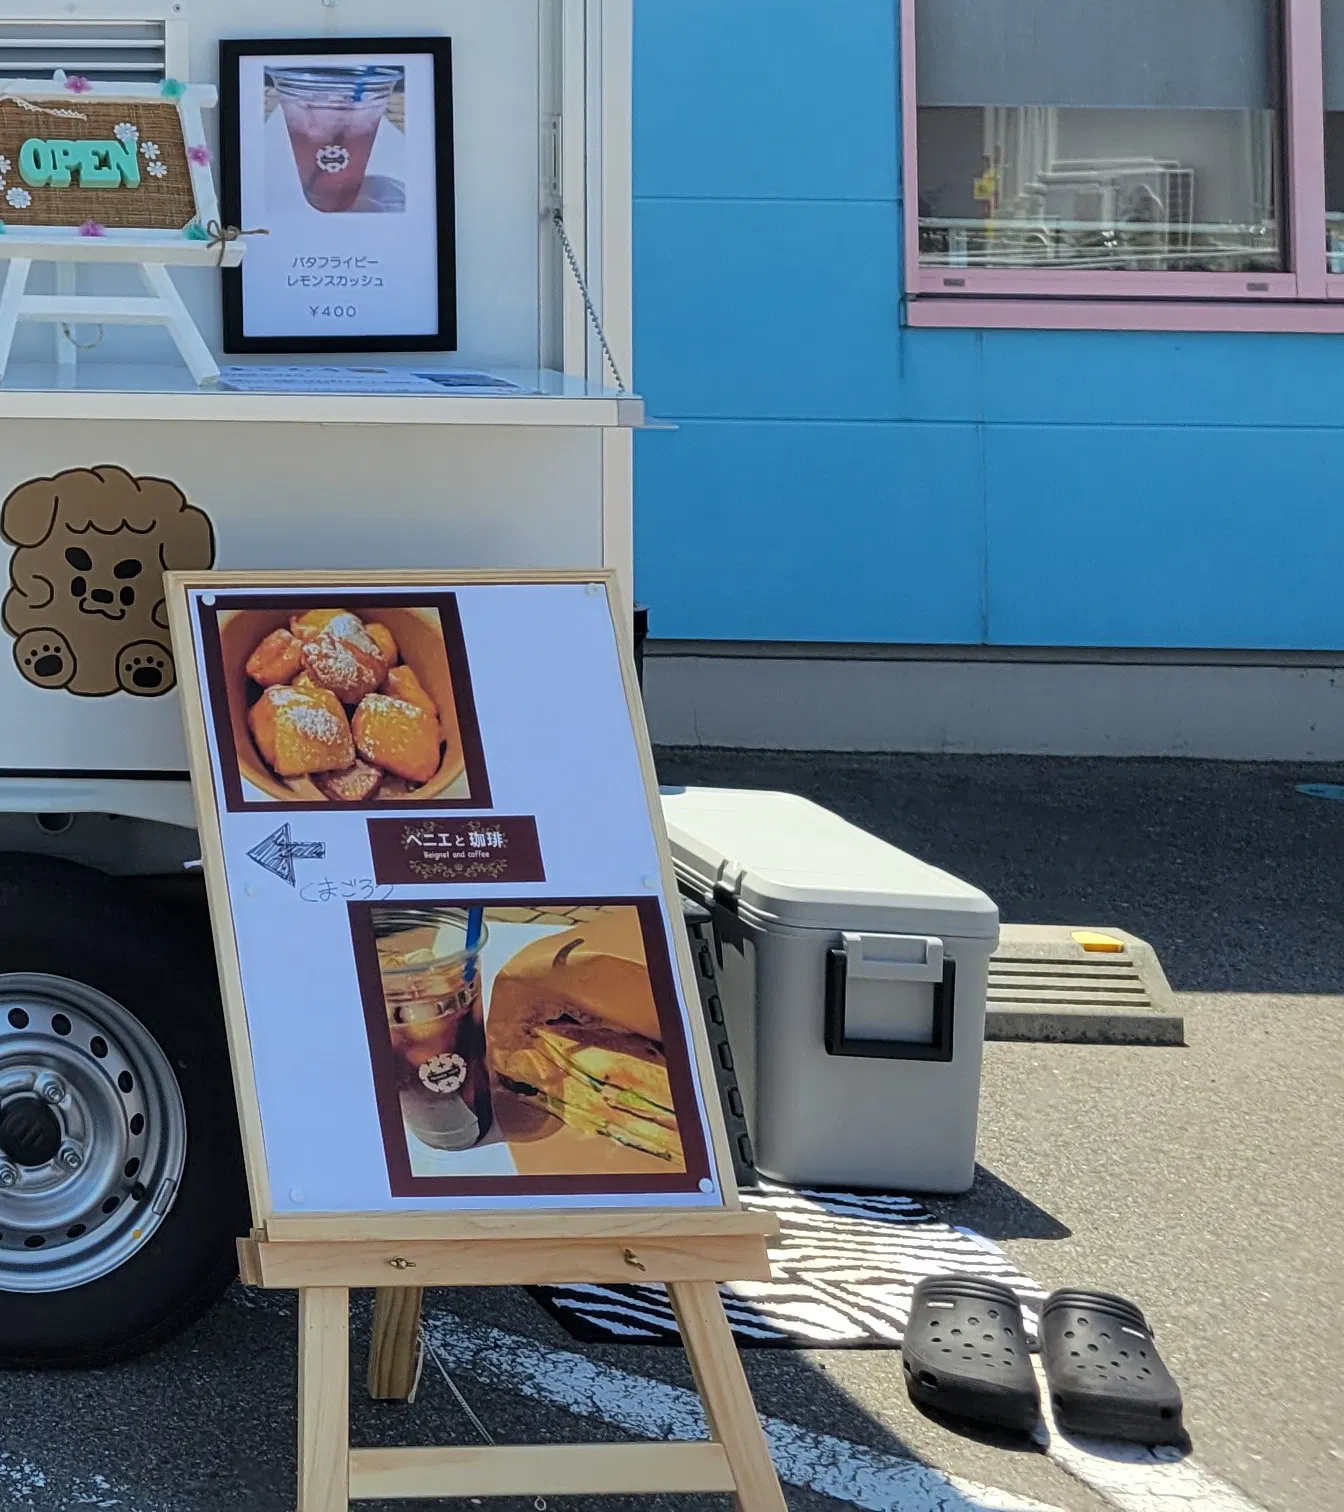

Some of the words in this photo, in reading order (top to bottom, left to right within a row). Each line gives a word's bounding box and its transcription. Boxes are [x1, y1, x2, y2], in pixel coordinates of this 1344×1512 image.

[18, 137, 141, 189] OPEN
[287, 275, 384, 287] レモンスカッシュ
[309, 305, 357, 318] ¥400
[406, 831, 505, 848] ベニエと珈琲
[423, 850, 449, 860] Beignet
[452, 850, 466, 858] and
[467, 850, 490, 858] coffee
